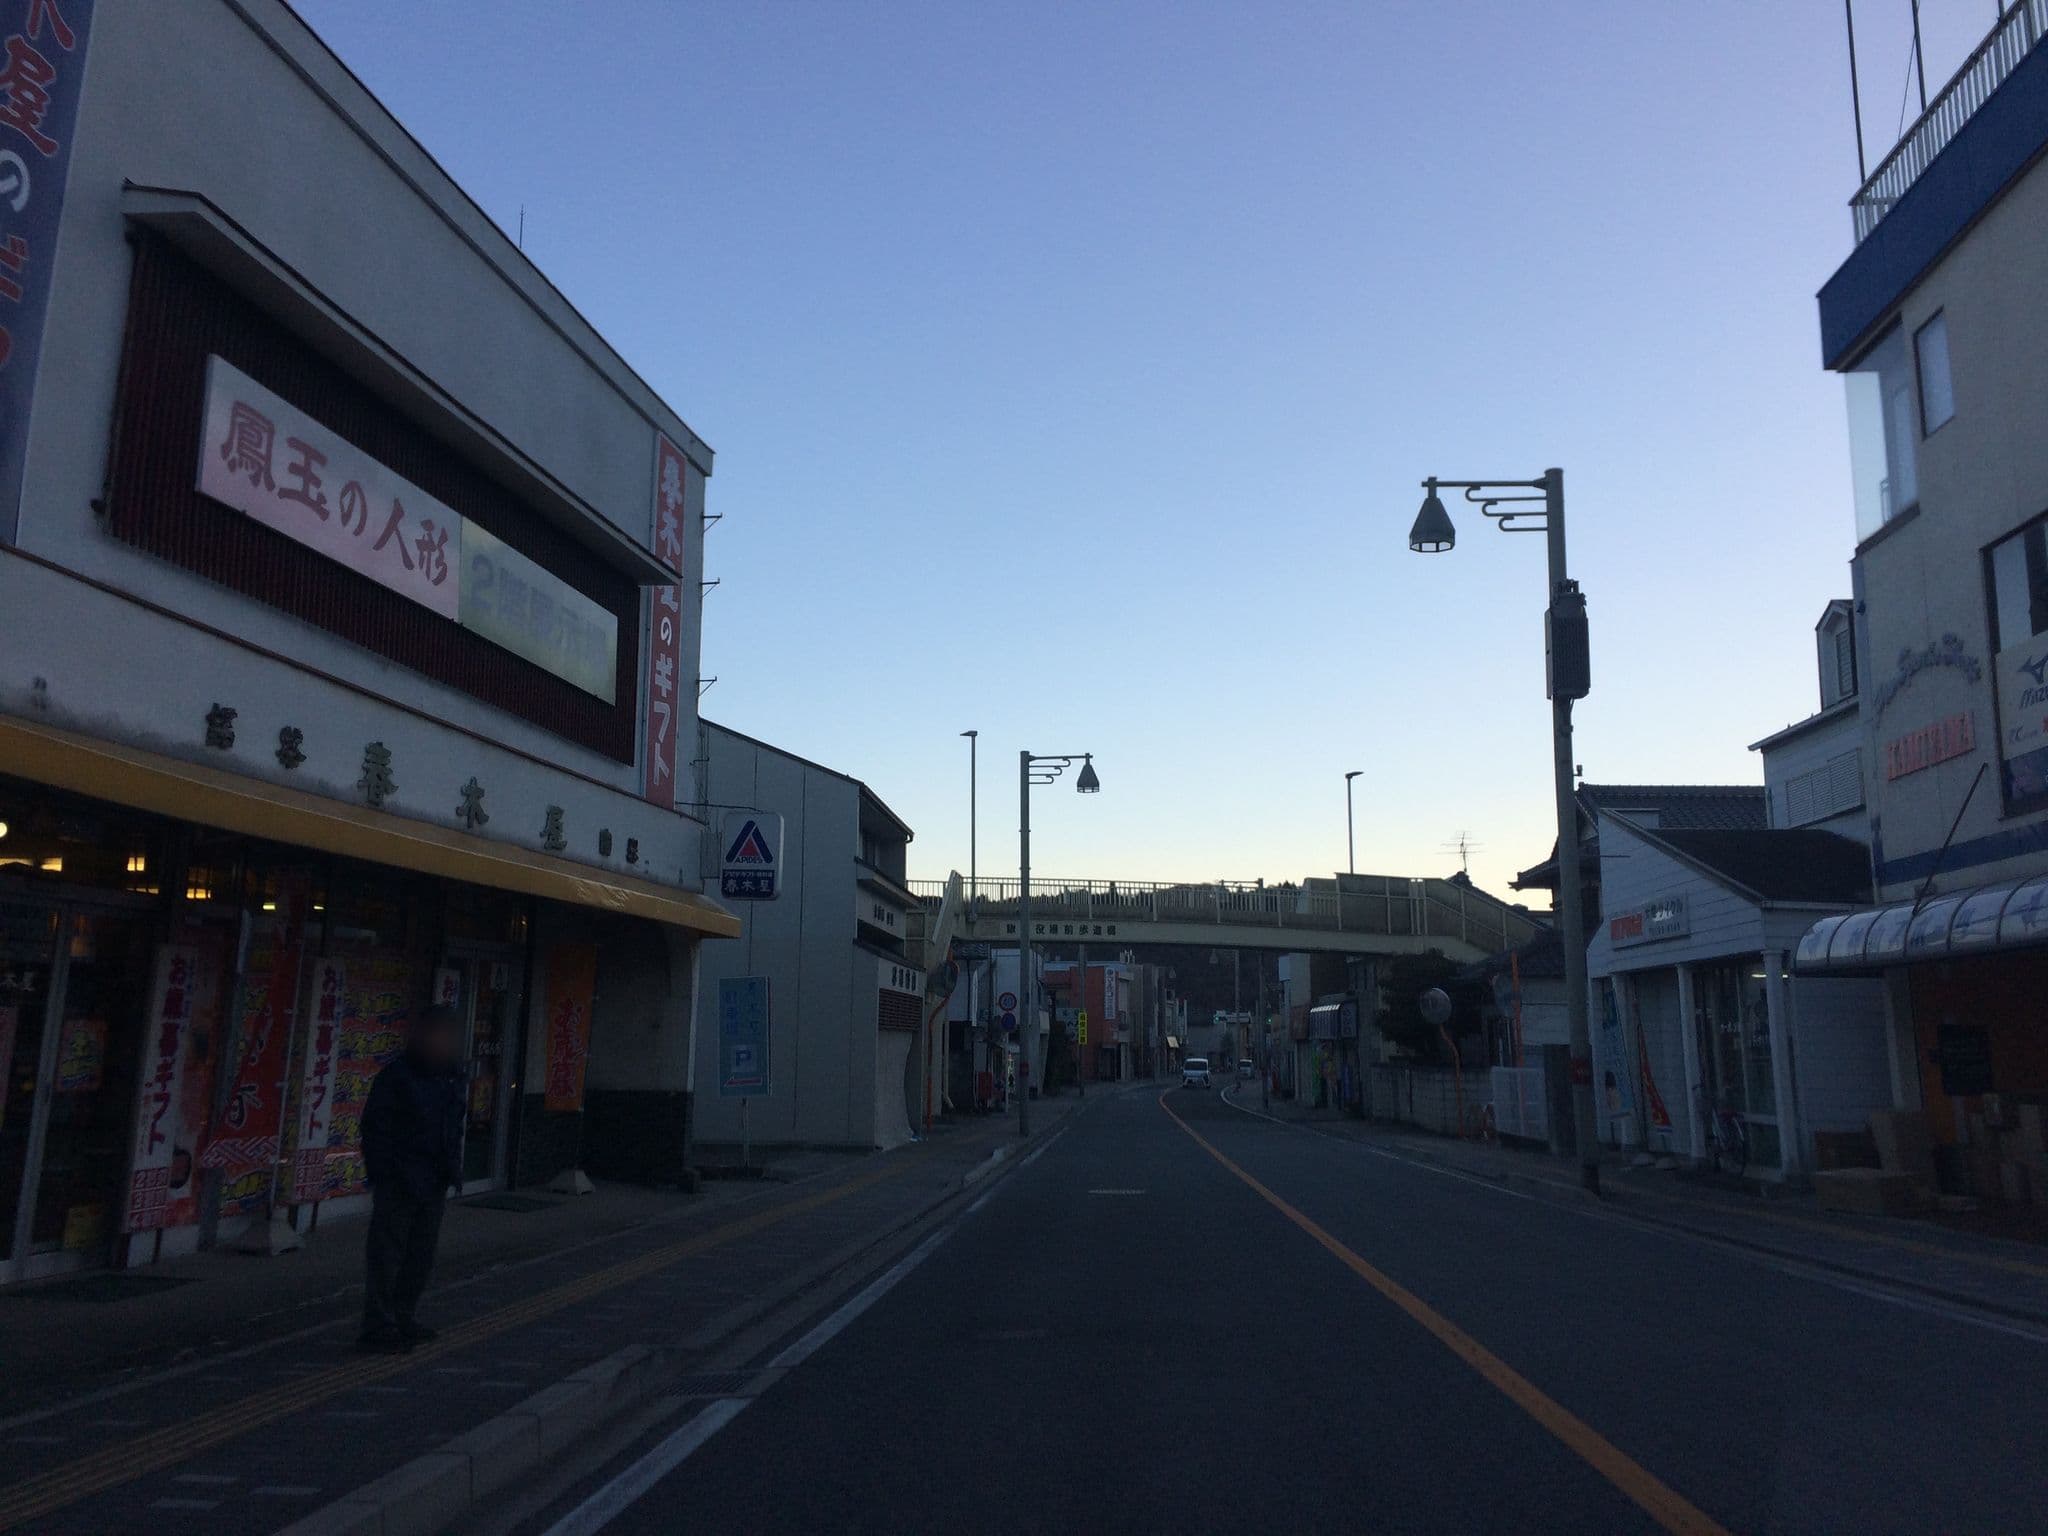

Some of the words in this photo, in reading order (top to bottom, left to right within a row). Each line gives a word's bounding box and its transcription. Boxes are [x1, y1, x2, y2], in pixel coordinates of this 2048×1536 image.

[221, 400, 449, 587] 鳳玉の人形
[736, 1048, 752, 1066] P
